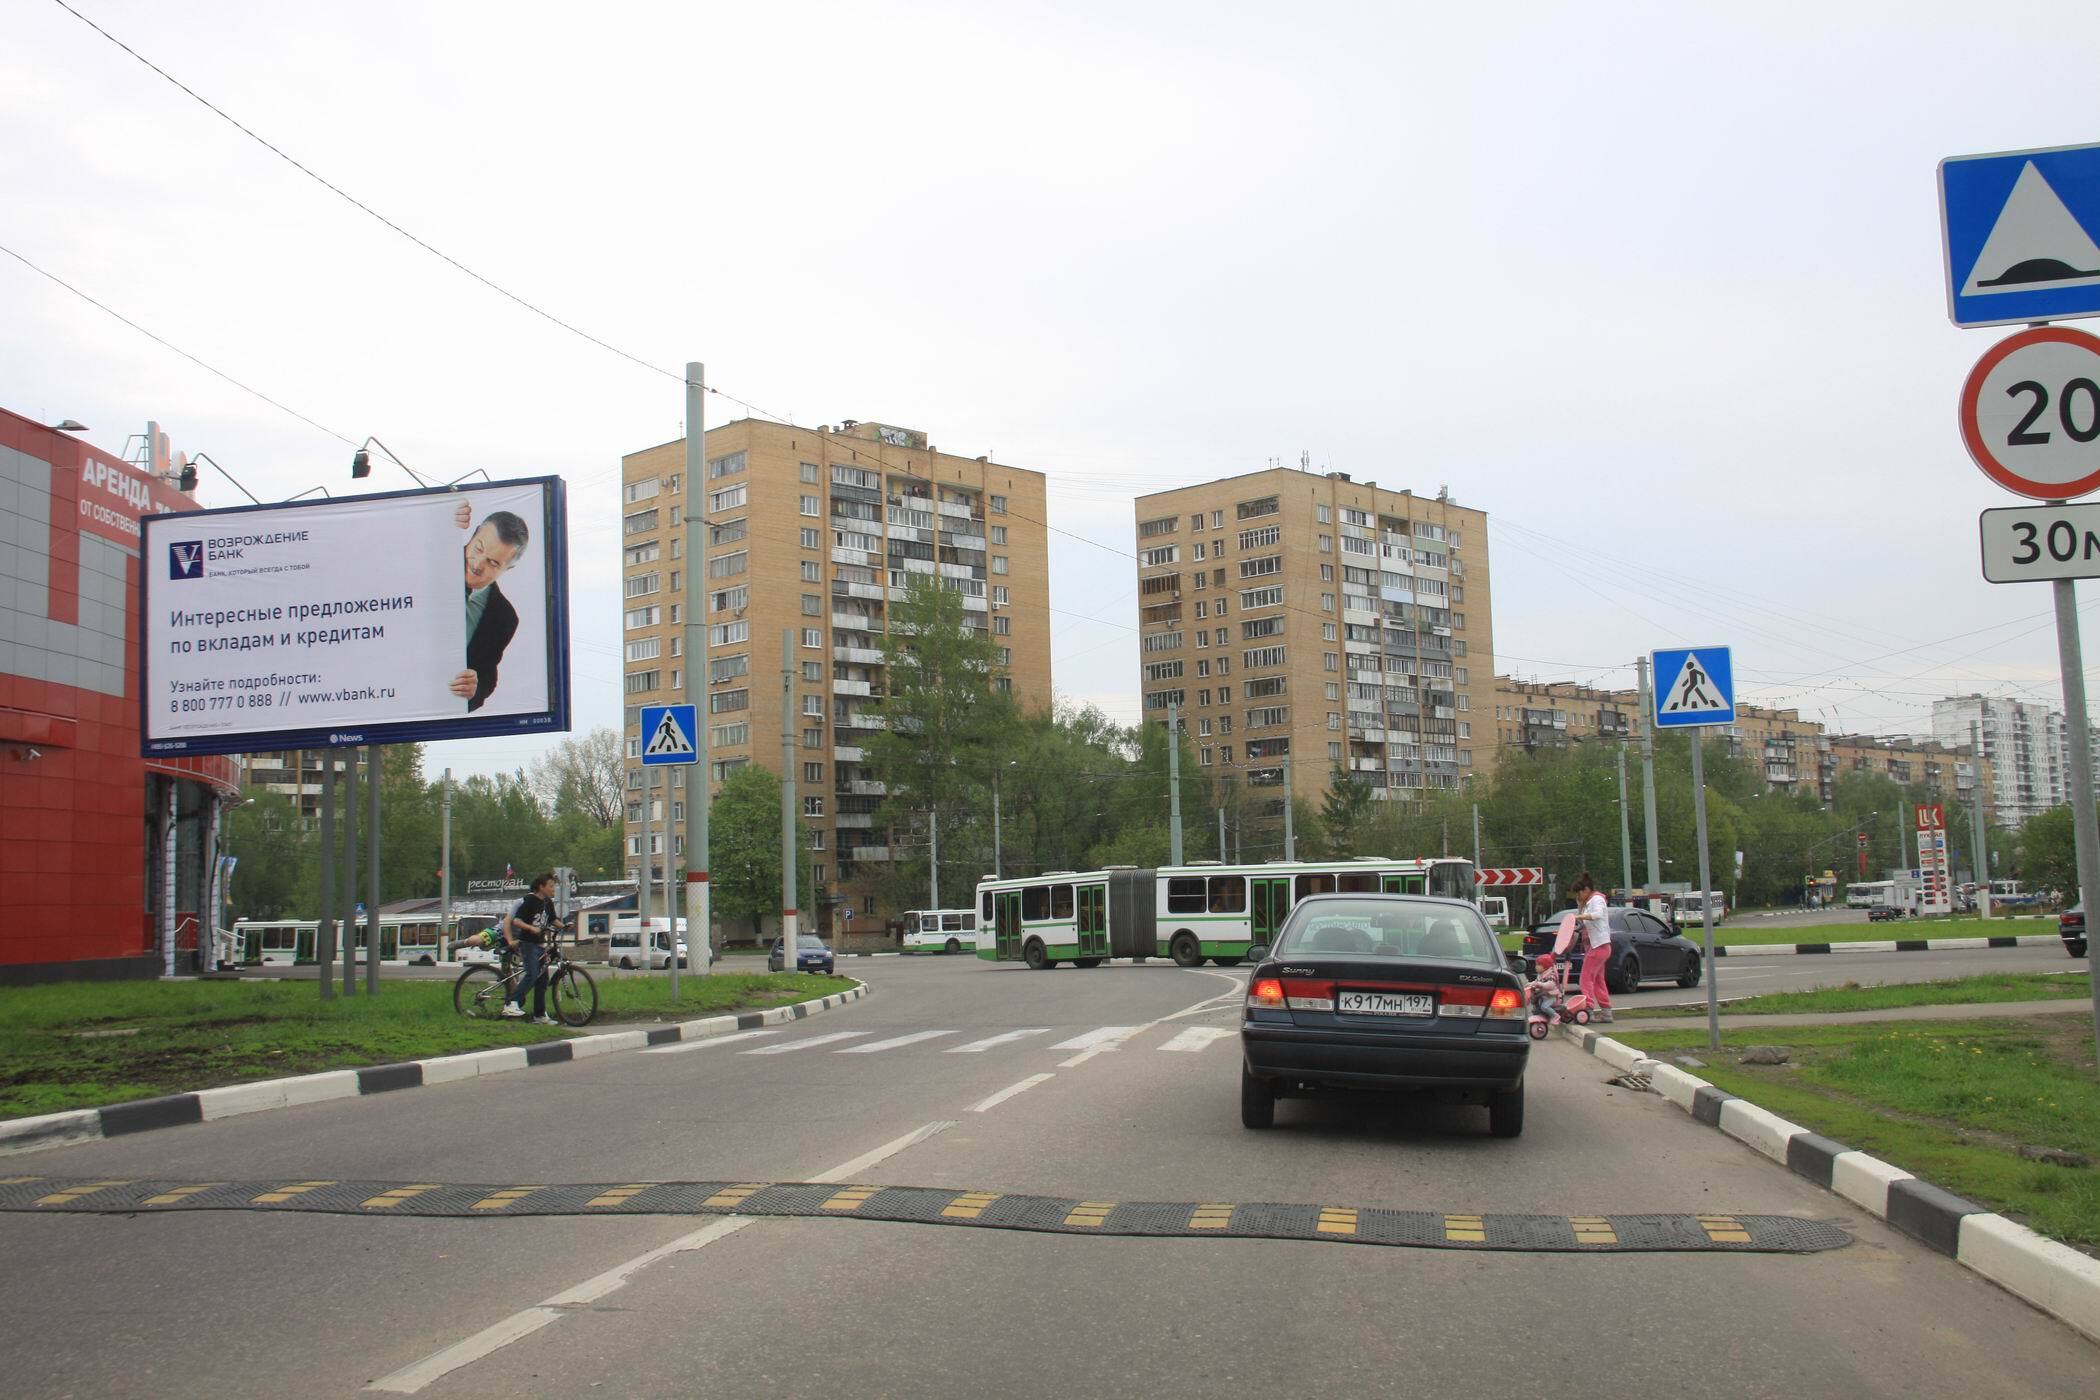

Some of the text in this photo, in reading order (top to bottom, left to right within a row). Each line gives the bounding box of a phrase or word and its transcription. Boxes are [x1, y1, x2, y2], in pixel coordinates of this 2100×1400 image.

[2006, 377, 2100, 446] 20
[82, 457, 151, 510] АРЕНДА
[80, 499, 92, 517] ОТ
[208, 530, 309, 549] ВОЗРОЖДЕНИЕ
[208, 549, 244, 561] БАНК
[259, 566, 283, 574] ВСЕГДА
[290, 563, 310, 571] ТОБОЙ
[171, 595, 413, 628] Интересные предложения
[171, 624, 384, 653] по вкладам и кредитам
[170, 673, 322, 693] Узнайте подробности:
[171, 700, 179, 712] 8
[183, 698, 205, 712] 800
[209, 696, 233, 710] 777
[237, 695, 245, 708] 0
[249, 693, 272, 708] 888
[298, 685, 395, 704] www.vbank.ru
[339, 733, 364, 742] News
[467, 878, 524, 893] ресторан
[1282, 966, 1316, 976] Sunny
[1344, 994, 1428, 1011] К917МН 197
